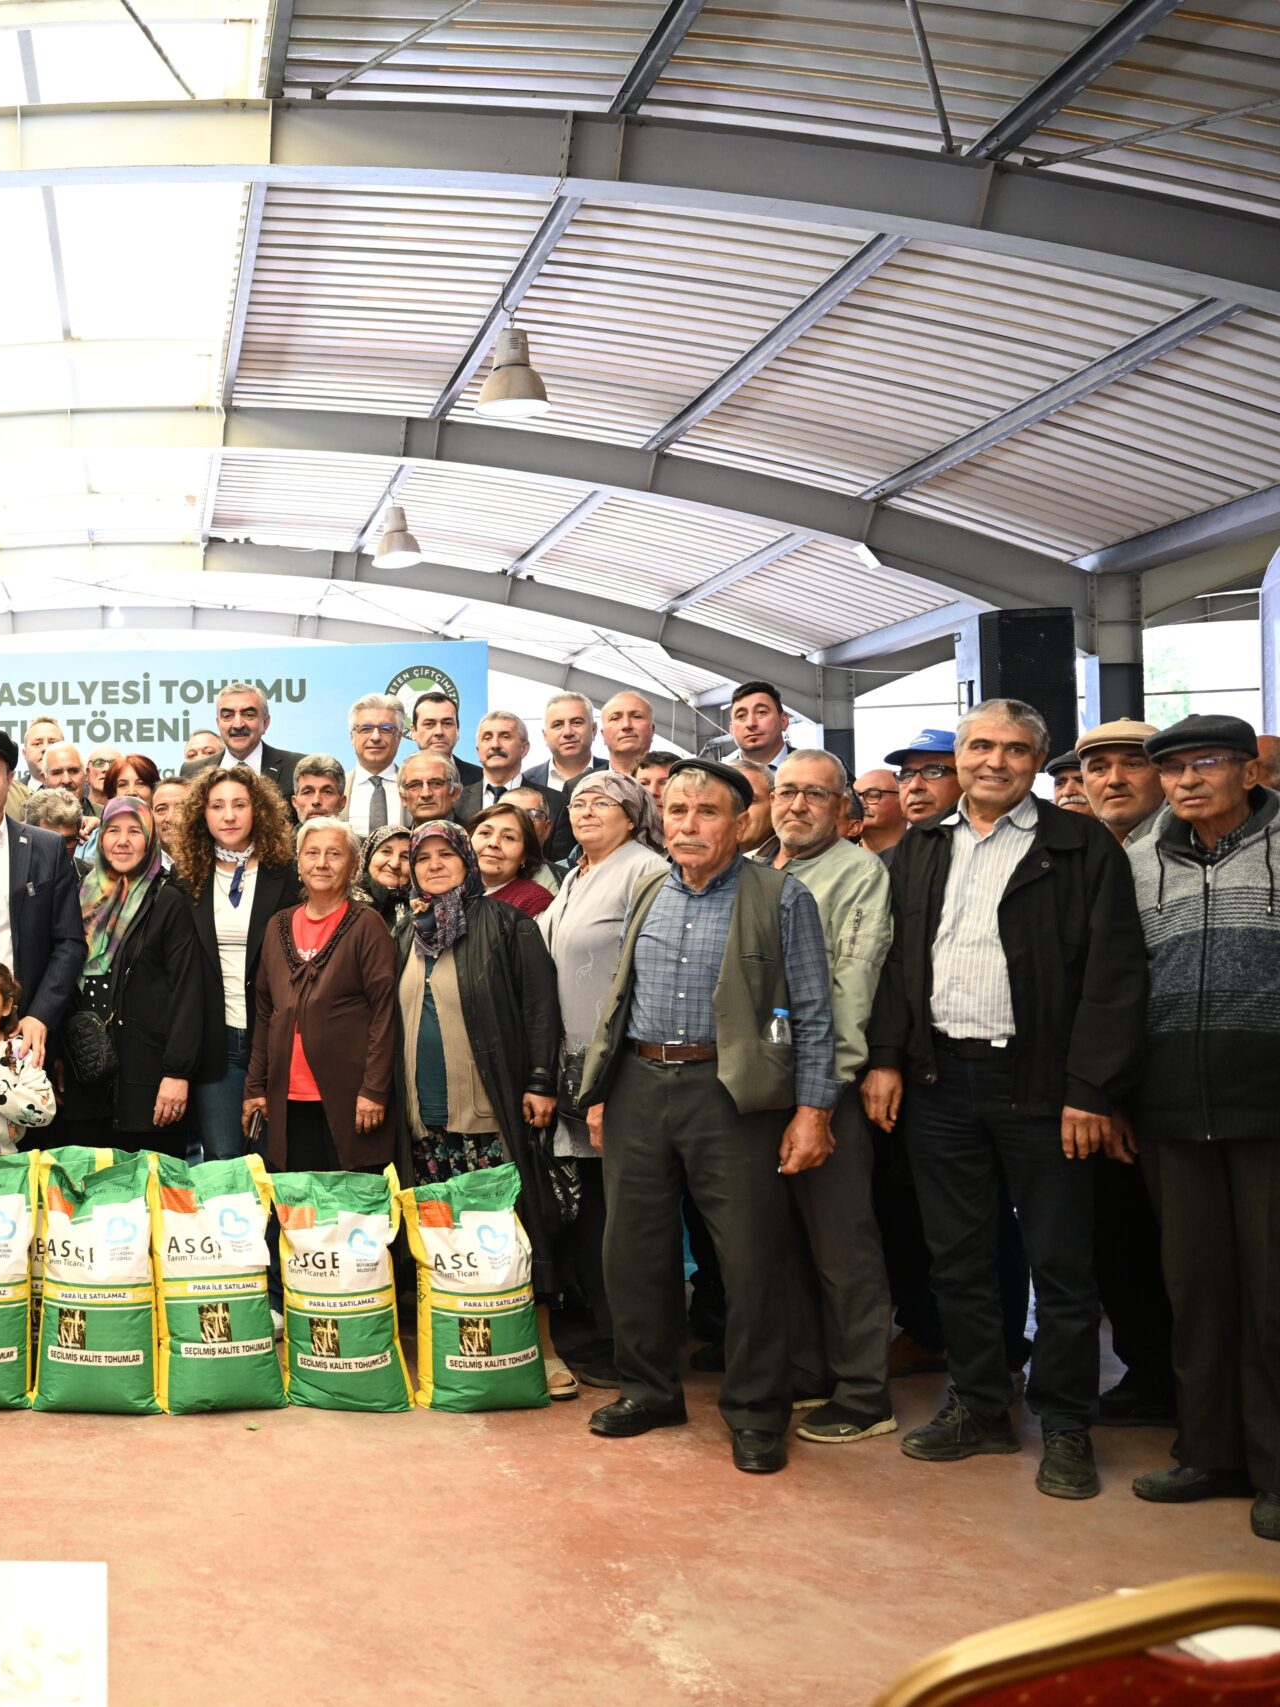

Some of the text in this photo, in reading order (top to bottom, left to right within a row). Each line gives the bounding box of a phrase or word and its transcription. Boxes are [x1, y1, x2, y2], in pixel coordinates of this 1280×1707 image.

[389, 672, 410, 693] ETEN
[159, 678, 306, 704] TOHMU
[66, 709, 190, 743] TÖRENİ
[167, 1254, 188, 1262] Tarım
[303, 1268, 327, 1278] Ticaret
[224, 1282, 258, 1290] SATILAMAZ
[308, 1297, 375, 1308] PARA İLE SATILAMAZ
[483, 1300, 494, 1308] İLE
[495, 1295, 527, 1307] SATILAMAZ
[184, 1341, 271, 1357] SEÇİLMİŞ KALİTE TOHUMLAR
[50, 1350, 140, 1363] SEÇİLMİŞ KALİTE TOHUMLAR
[299, 1355, 388, 1370] SEÇİLMİŞ KALİTE TOHUMLAR
[449, 1349, 537, 1369] SEÇİLMİŞ KALİTE TOHUMLAR
